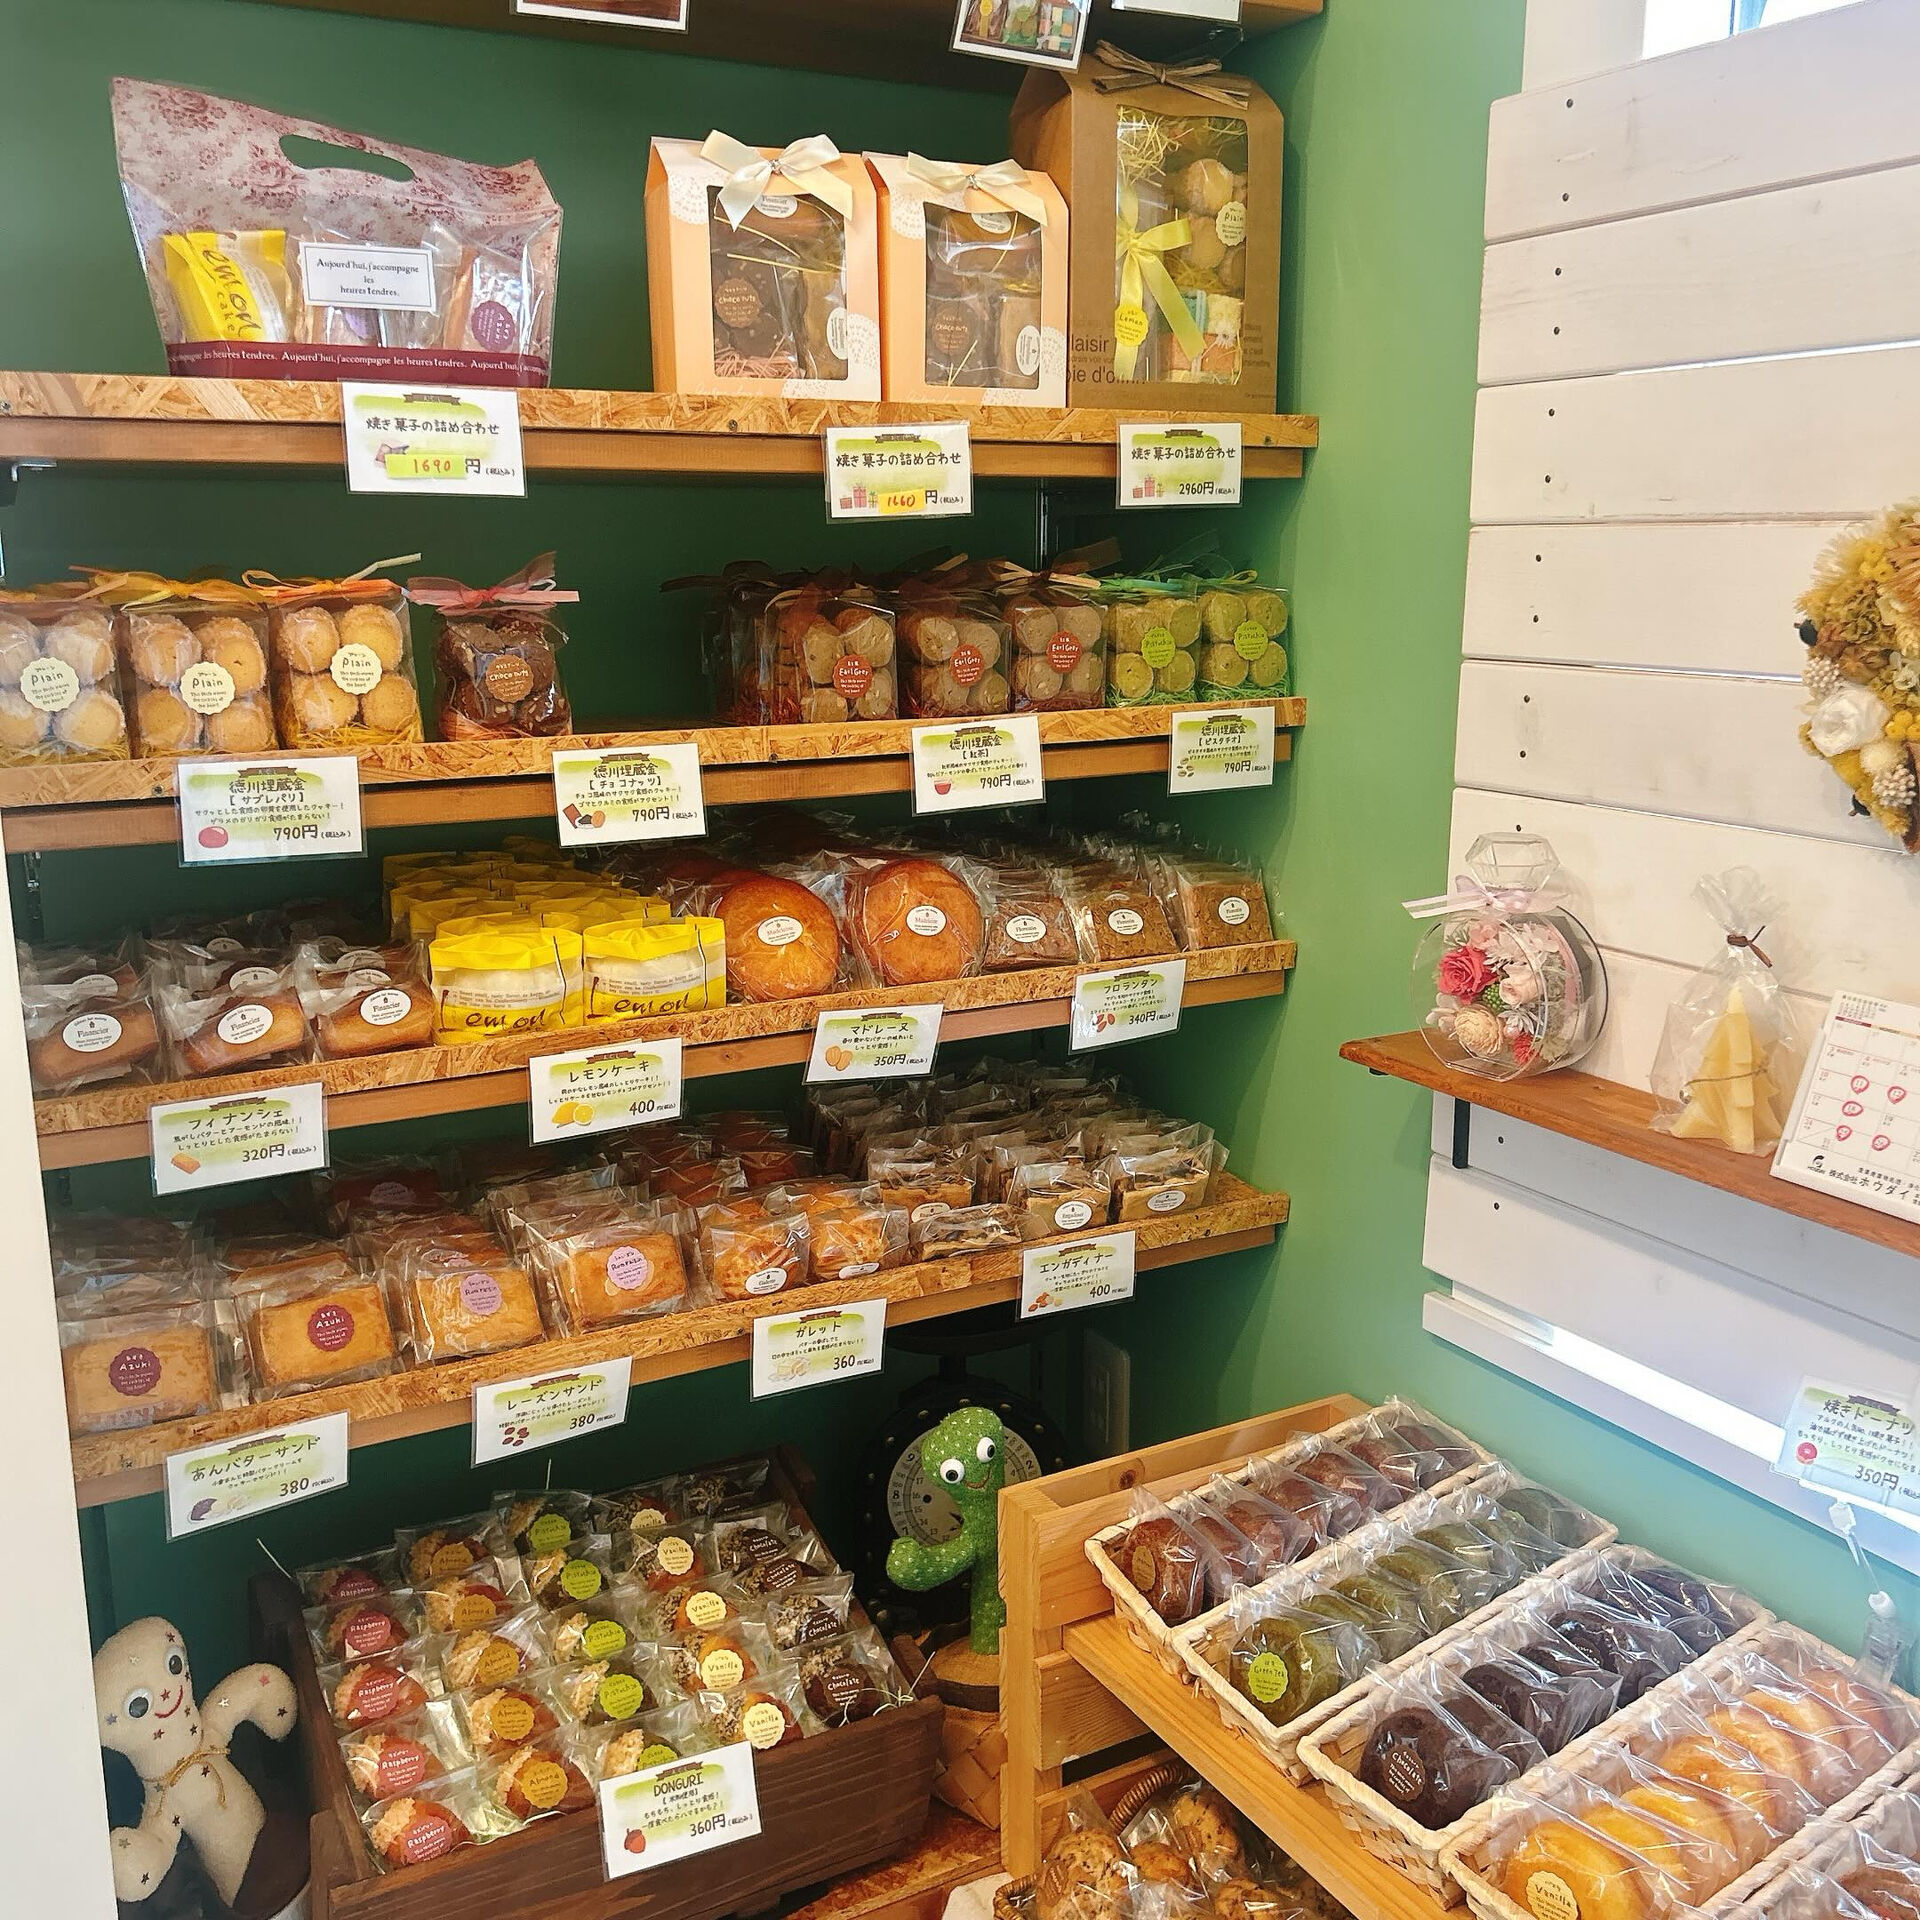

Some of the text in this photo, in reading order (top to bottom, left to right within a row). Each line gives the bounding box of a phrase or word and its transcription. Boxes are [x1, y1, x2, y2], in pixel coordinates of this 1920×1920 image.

[364, 275, 374, 284] les
[340, 285, 400, 297] heures tendres.
[1071, 333, 1109, 352] laisir
[212, 350, 240, 360] heures
[242, 350, 277, 361] tendres.
[393, 356, 404, 366] les
[406, 358, 433, 368] heures
[434, 359, 467, 369] tendres.
[366, 416, 500, 436] 焼き菓子の詰め合わせ
[836, 452, 962, 467] 焼き菓子の詰め合わせ
[1131, 446, 1237, 460] 焼き菓子の詰め合わせ
[413, 458, 451, 474] 1690
[343, 657, 371, 668] Plain
[32, 673, 63, 686] Plain
[193, 678, 223, 689] Plain
[1201, 723, 1248, 736] 徳川埋蔵金
[949, 734, 1003, 751] 徳川埋蔵金
[593, 762, 658, 779] 徳川埋蔵金
[229, 777, 306, 794] 徳川埋蔵金
[1104, 979, 1158, 994] フロランタン
[851, 1022, 909, 1035] マドレーヌ
[570, 1060, 649, 1083] レモンケーキ
[629, 1100, 655, 1116] 400
[188, 1108, 283, 1130] フィナンシェ
[1039, 1253, 1113, 1274] エンガディナー
[1090, 1284, 1110, 1298] 400
[316, 1318, 345, 1328] Azuki
[796, 1321, 841, 1338] ガレット
[120, 1363, 150, 1372] Azuki
[833, 1354, 855, 1370] 360
[507, 1379, 603, 1410] レーズンサンド
[569, 1413, 595, 1430] 380
[1823, 1400, 1915, 1435] 焼きドーナツ
[191, 1436, 321, 1482] あんバターサンド
[279, 1478, 310, 1497] 380
[662, 1545, 689, 1557] Vanilla
[691, 1600, 719, 1613] Vanilla
[350, 1620, 386, 1633] Raspberry
[707, 1662, 739, 1673] Vanilla
[358, 1682, 394, 1698] Raspberry
[748, 1714, 778, 1729] Vanilla
[382, 1754, 420, 1770] Raspberry
[1392, 1752, 1422, 1785] Chocolate
[654, 1773, 703, 1796] DONGURI
[407, 1825, 445, 1848] Raspberry
[1535, 1884, 1571, 1908] Vanilla
